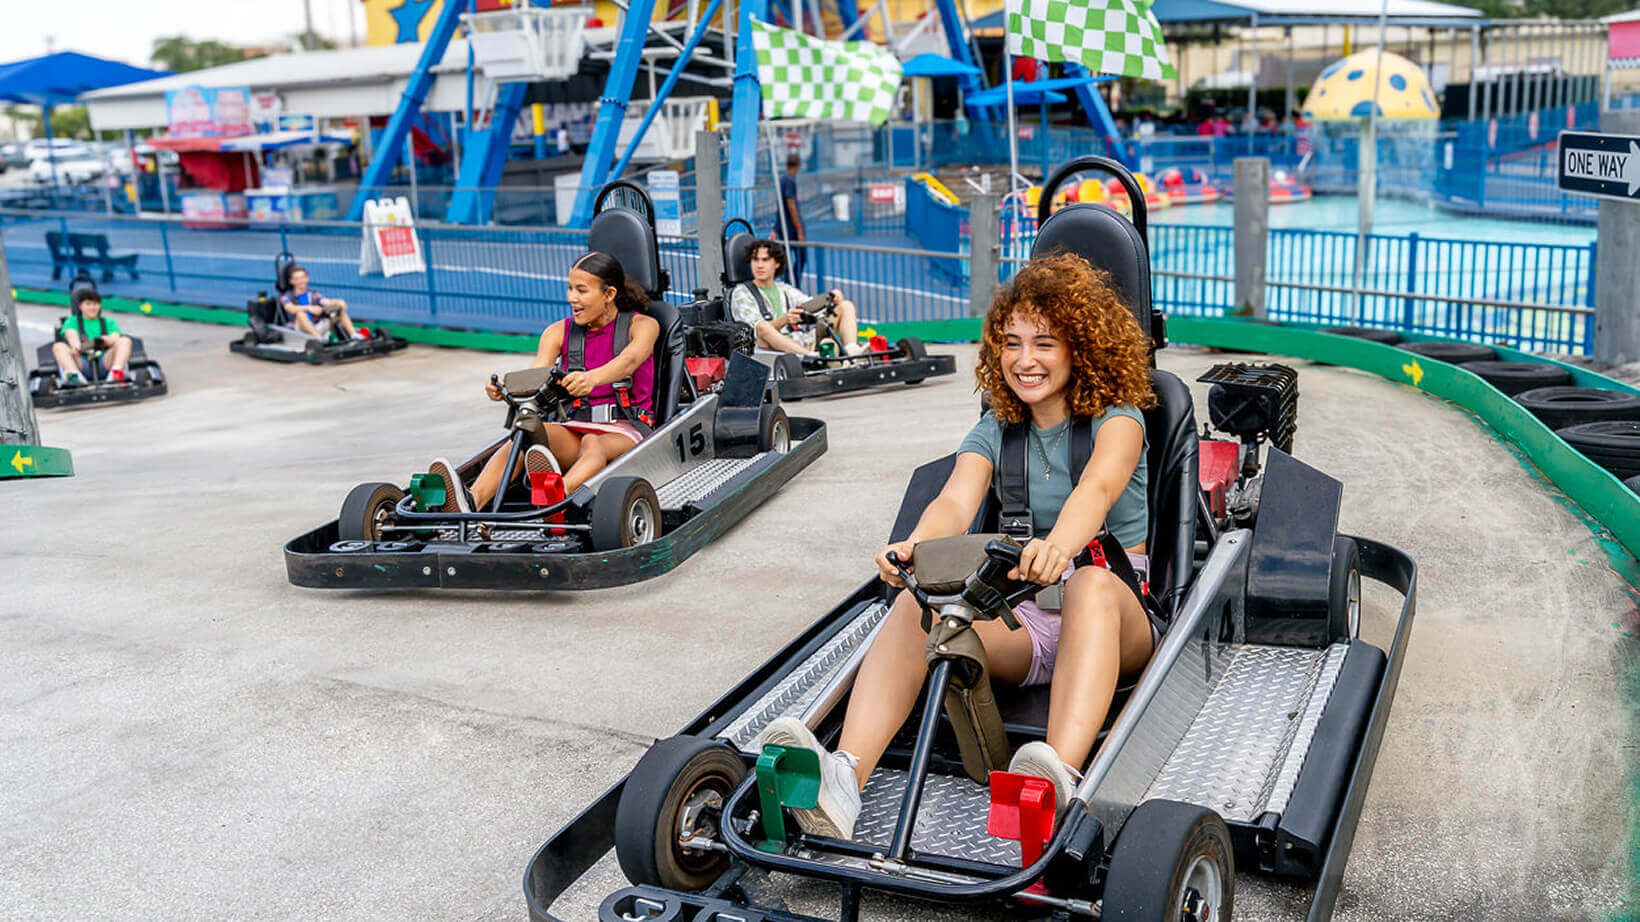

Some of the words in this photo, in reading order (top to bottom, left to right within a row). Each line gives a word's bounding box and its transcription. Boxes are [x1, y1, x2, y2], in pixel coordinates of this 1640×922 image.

[1568, 151, 1593, 175] ONE
[1598, 154, 1627, 178] WAY
[676, 422, 705, 463] 15
